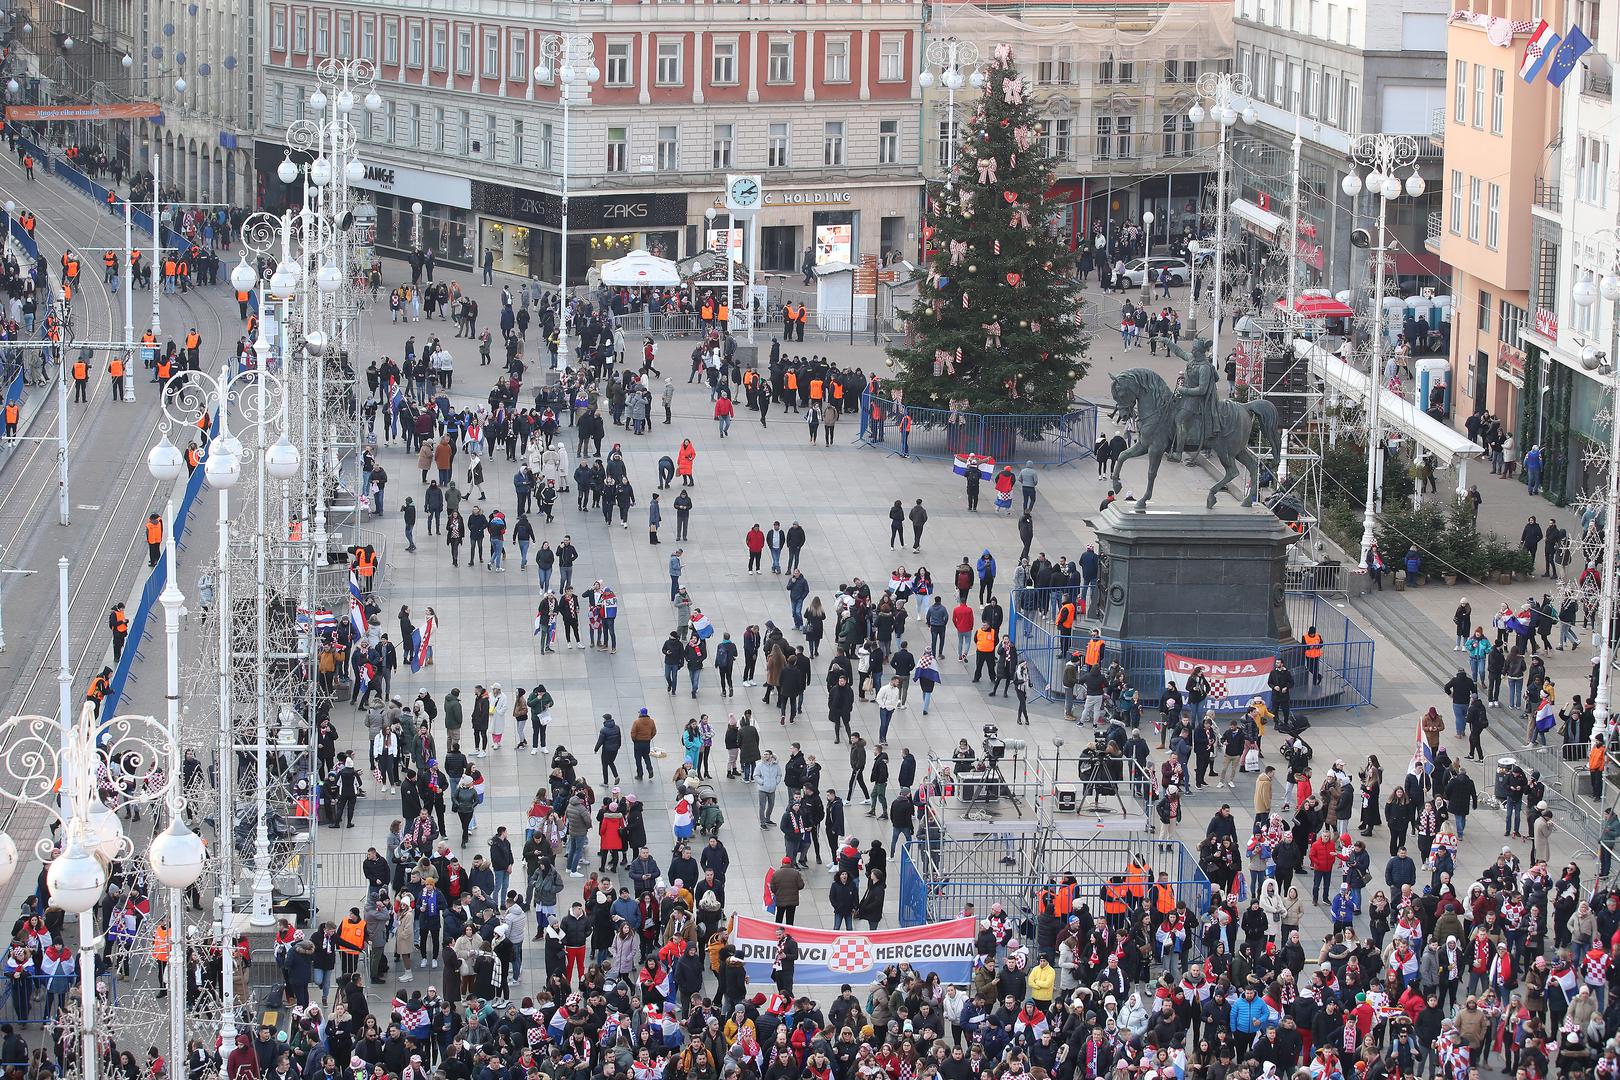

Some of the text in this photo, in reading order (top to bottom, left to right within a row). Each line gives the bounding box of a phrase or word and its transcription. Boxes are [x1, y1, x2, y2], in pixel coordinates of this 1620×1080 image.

[784, 192, 850, 204] HOLDING
[520, 197, 545, 215] ZAKS
[603, 203, 648, 218] ZAKS
[1179, 660, 1257, 674] DONJA
[742, 942, 974, 961] DRIVCI HERCEGOVINA
